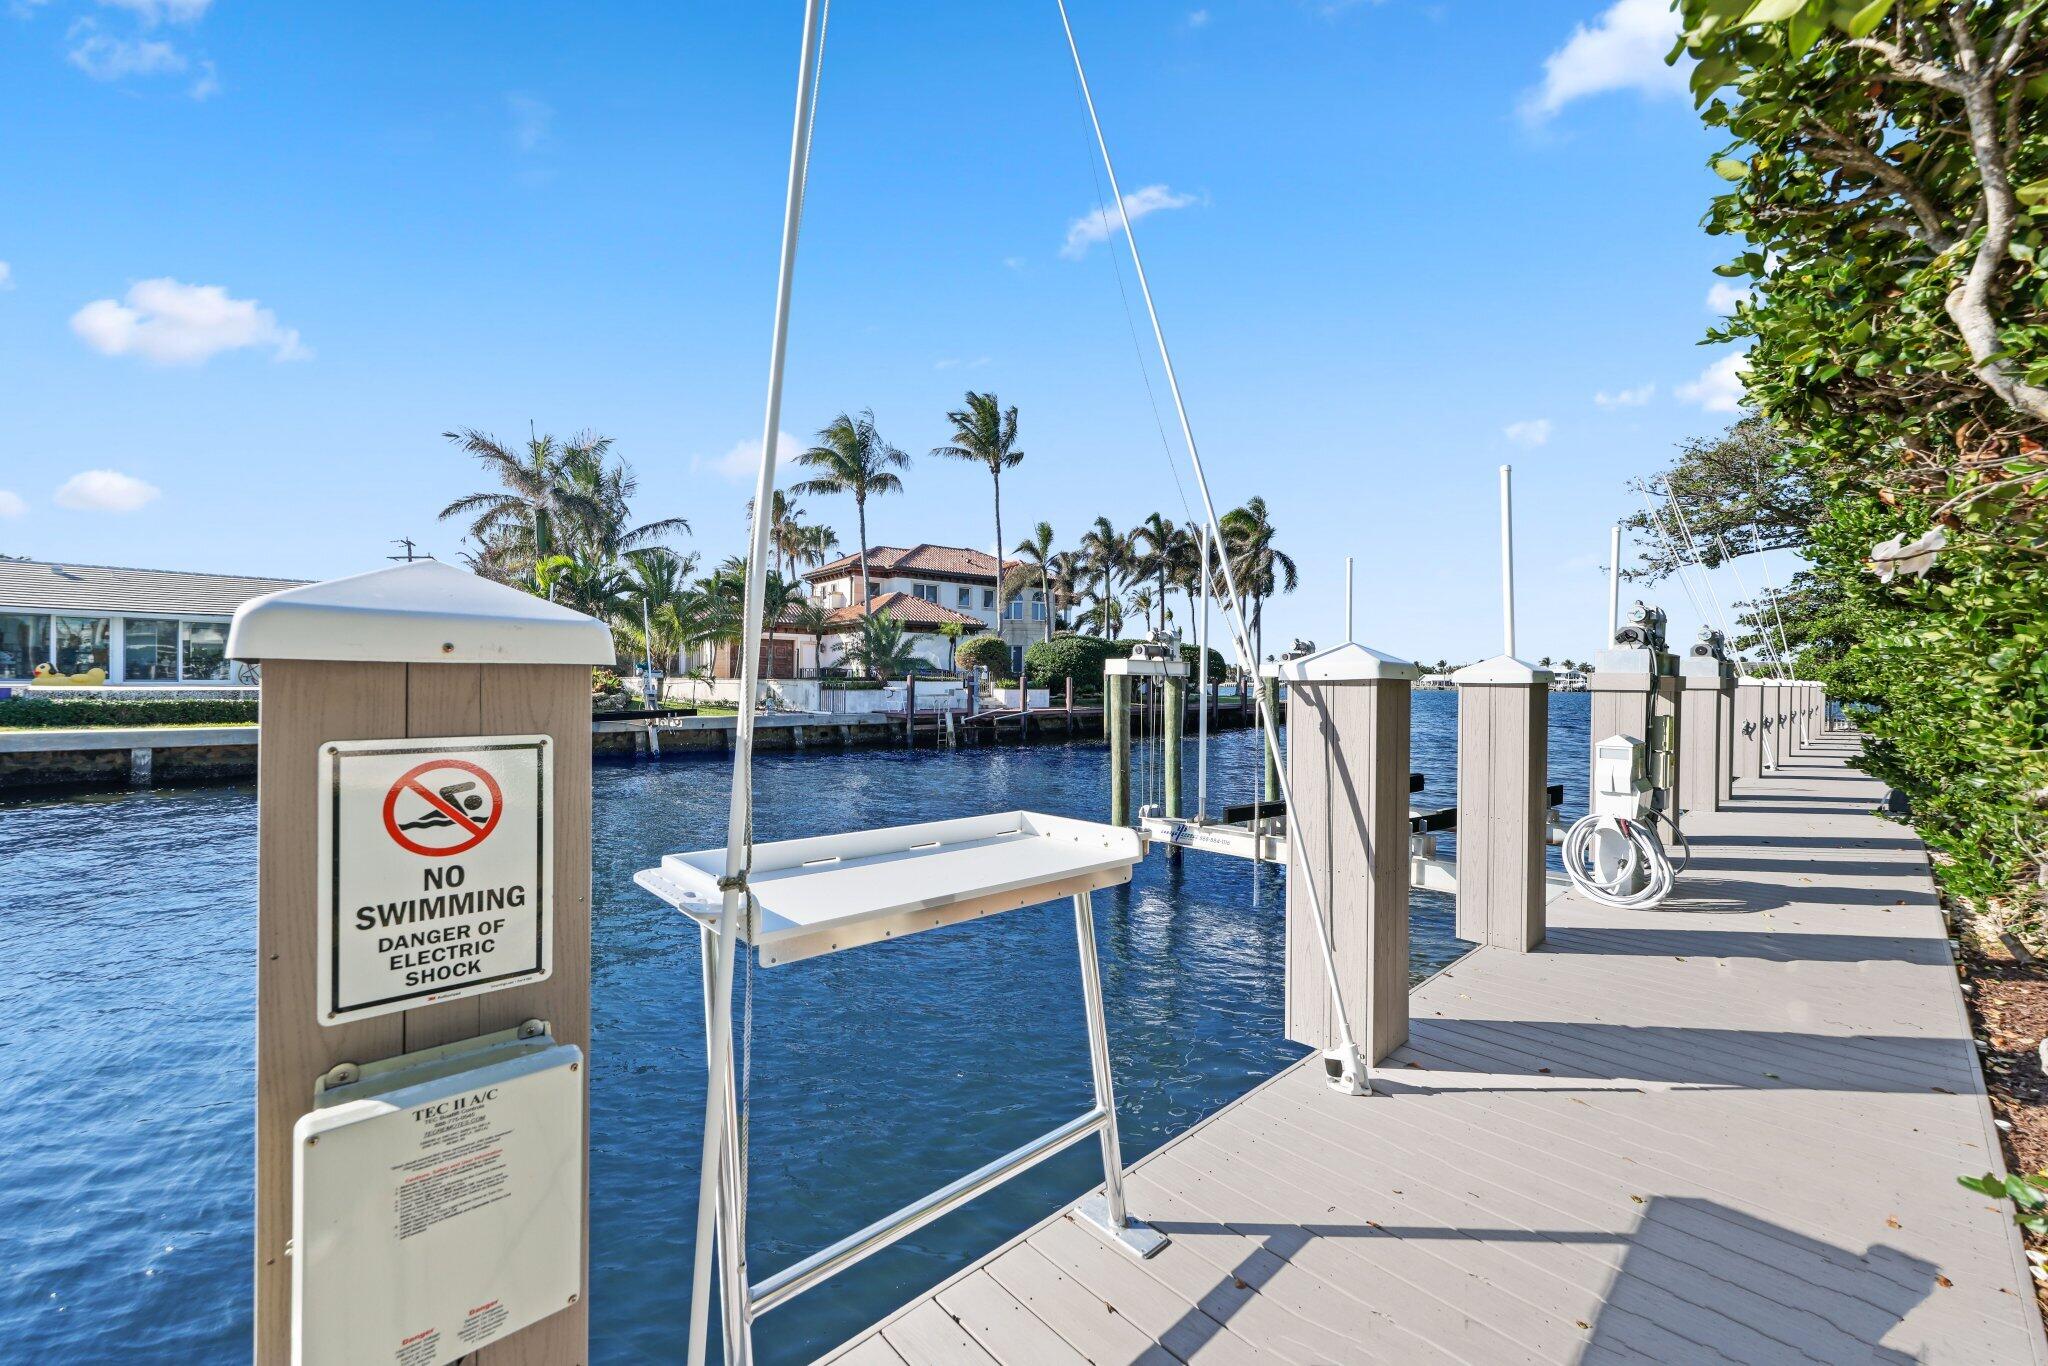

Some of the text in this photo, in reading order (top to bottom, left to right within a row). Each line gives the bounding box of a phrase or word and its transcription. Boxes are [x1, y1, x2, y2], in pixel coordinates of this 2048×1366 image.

[423, 864, 465, 891] NO
[355, 885, 526, 931] SWIMMING
[378, 918, 506, 953] DANGER OF
[389, 938, 496, 971] ELECTRIC
[405, 959, 482, 987] SHOCK
[412, 1088, 498, 1122] TEC II A/C
[425, 1116, 439, 1125] TEC
